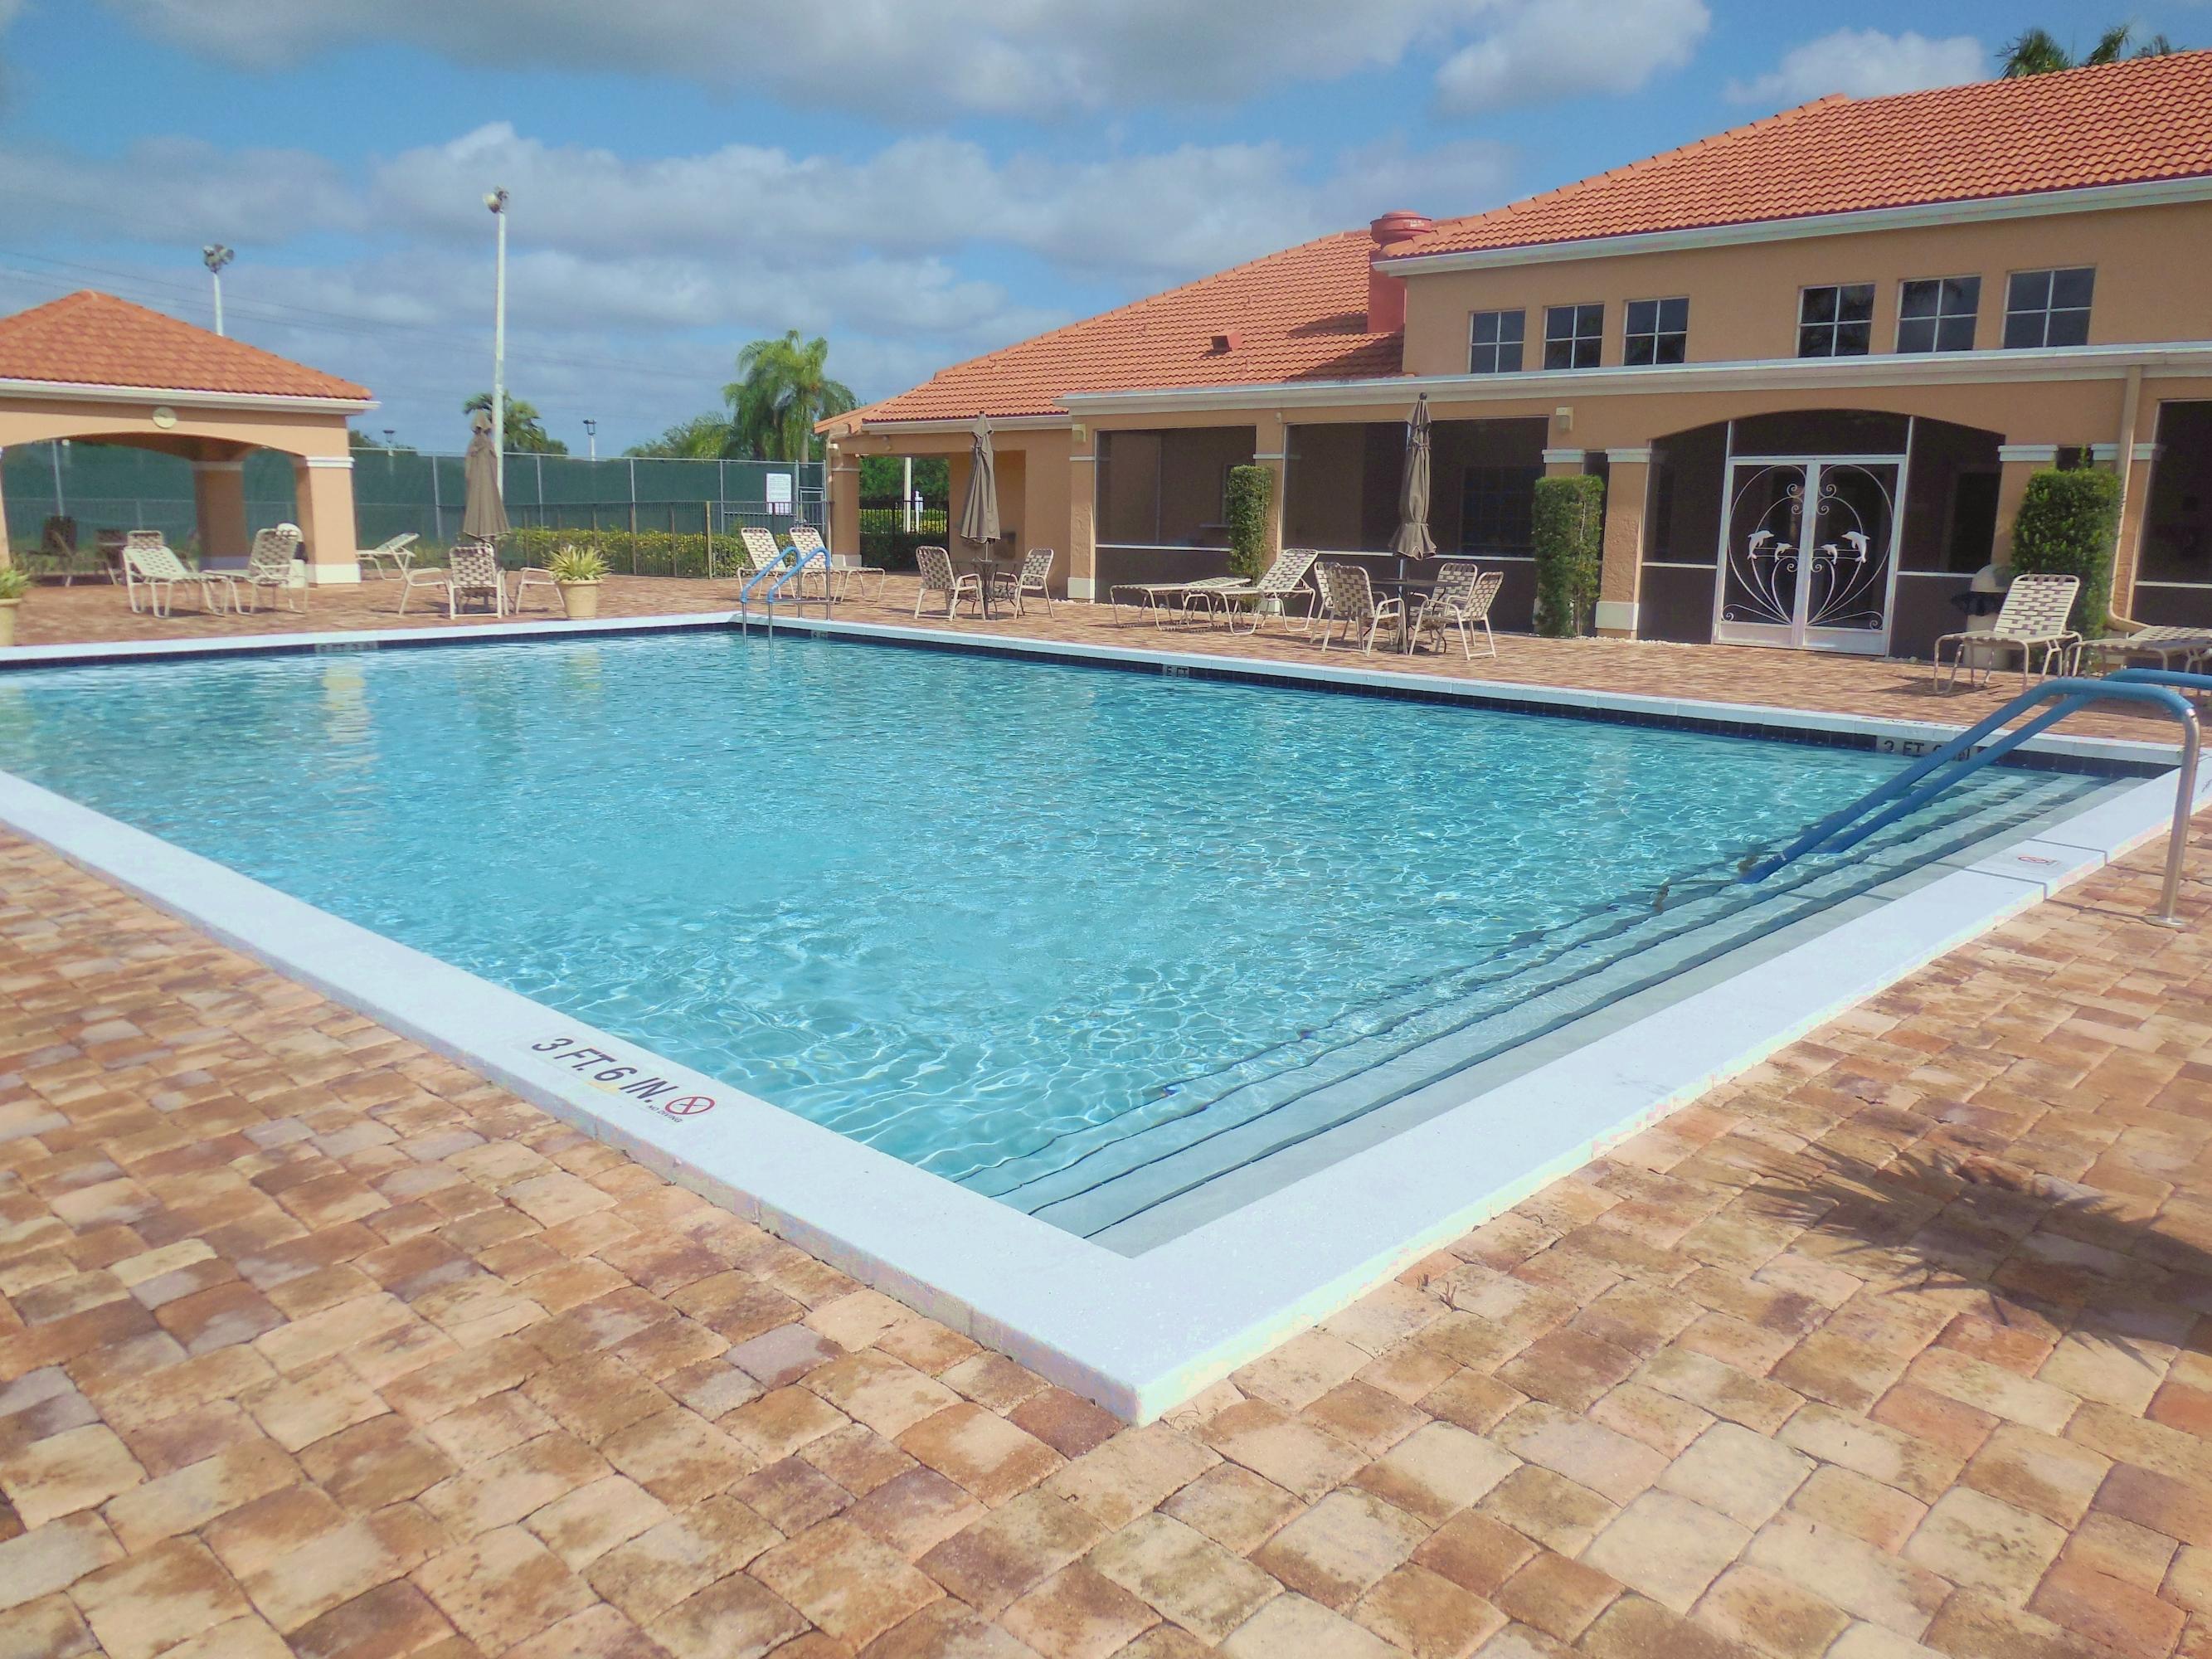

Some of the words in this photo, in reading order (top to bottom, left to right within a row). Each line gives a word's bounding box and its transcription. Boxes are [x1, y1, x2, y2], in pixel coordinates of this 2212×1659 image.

[1884, 740, 1895, 754] 3
[1903, 741, 1925, 757] FT
[532, 1038, 574, 1052] 3
[594, 1067, 638, 1082] 6
